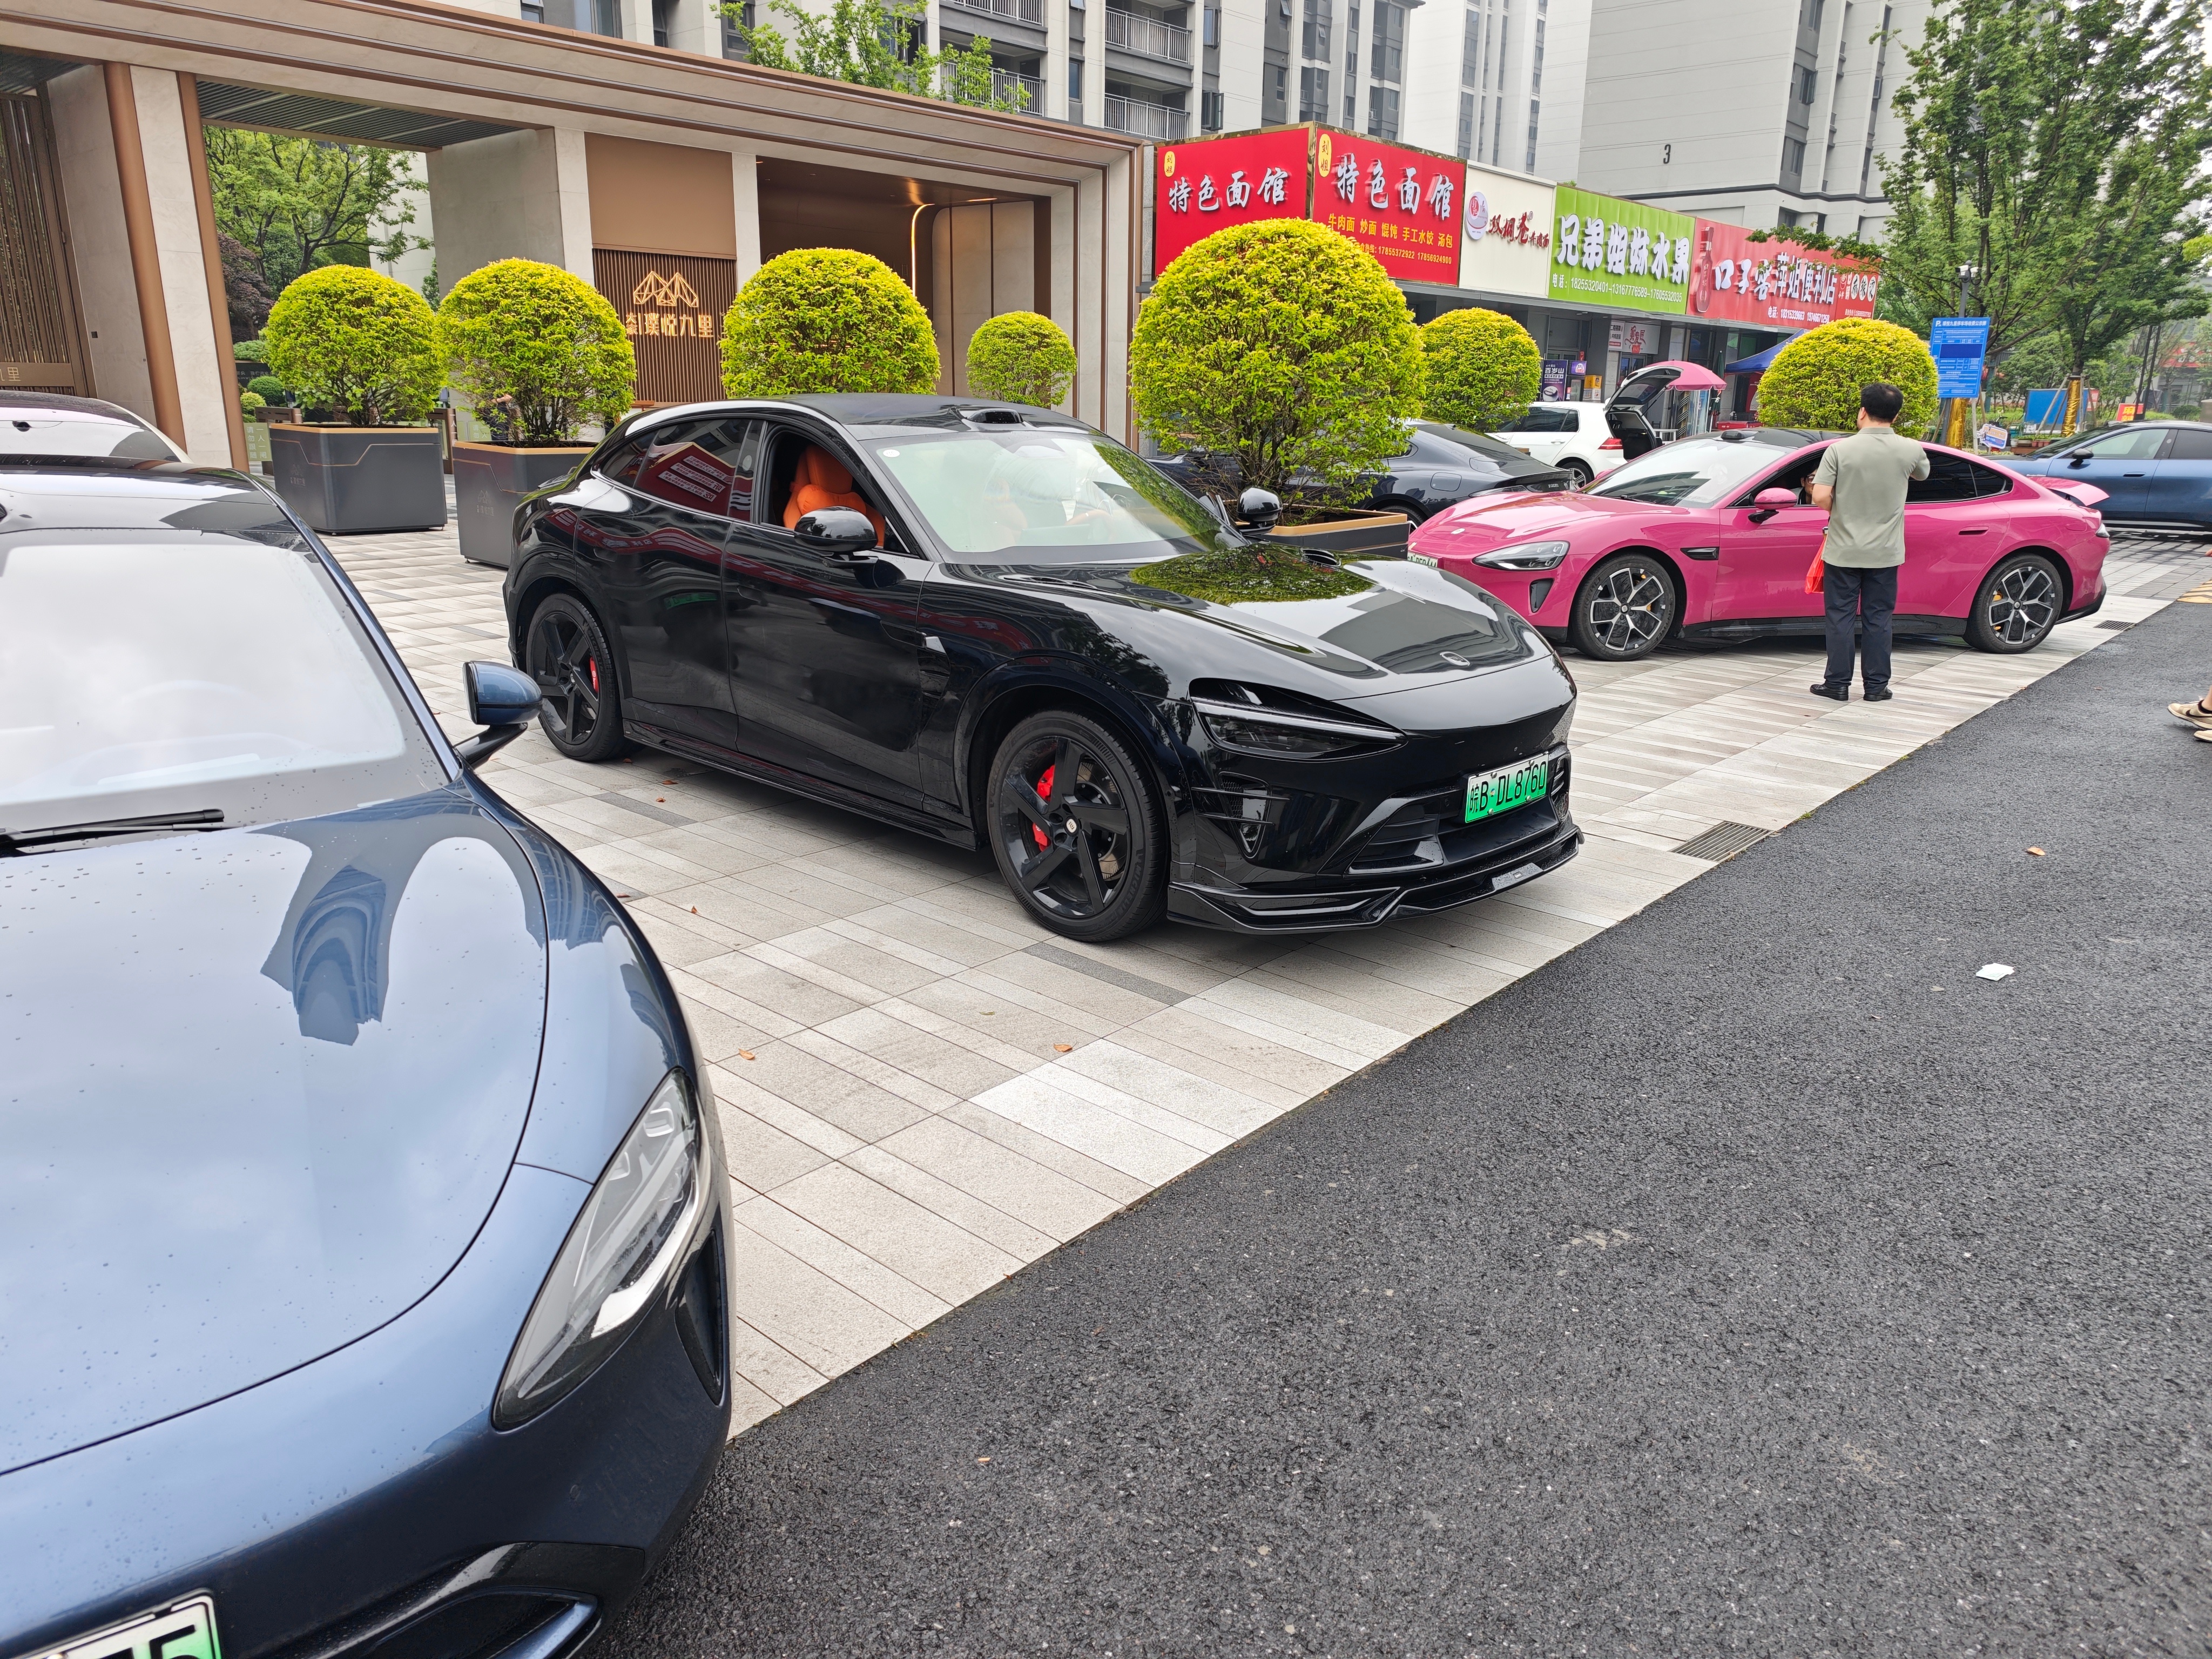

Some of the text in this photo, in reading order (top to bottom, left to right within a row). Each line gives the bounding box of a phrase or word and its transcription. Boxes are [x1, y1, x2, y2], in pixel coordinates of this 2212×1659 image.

[1663, 144, 1671, 164] 3
[1169, 167, 1289, 212] 特色面馆
[1337, 153, 1454, 221] 特色面馆
[1328, 213, 1453, 248] 牛肉面 炒面 馄饨 手工水饺 汤包
[1556, 213, 1690, 285] 兄弟姐妹水果
[1378, 246, 1415, 259] 17855372922
[1417, 252, 1452, 265] 17856924900
